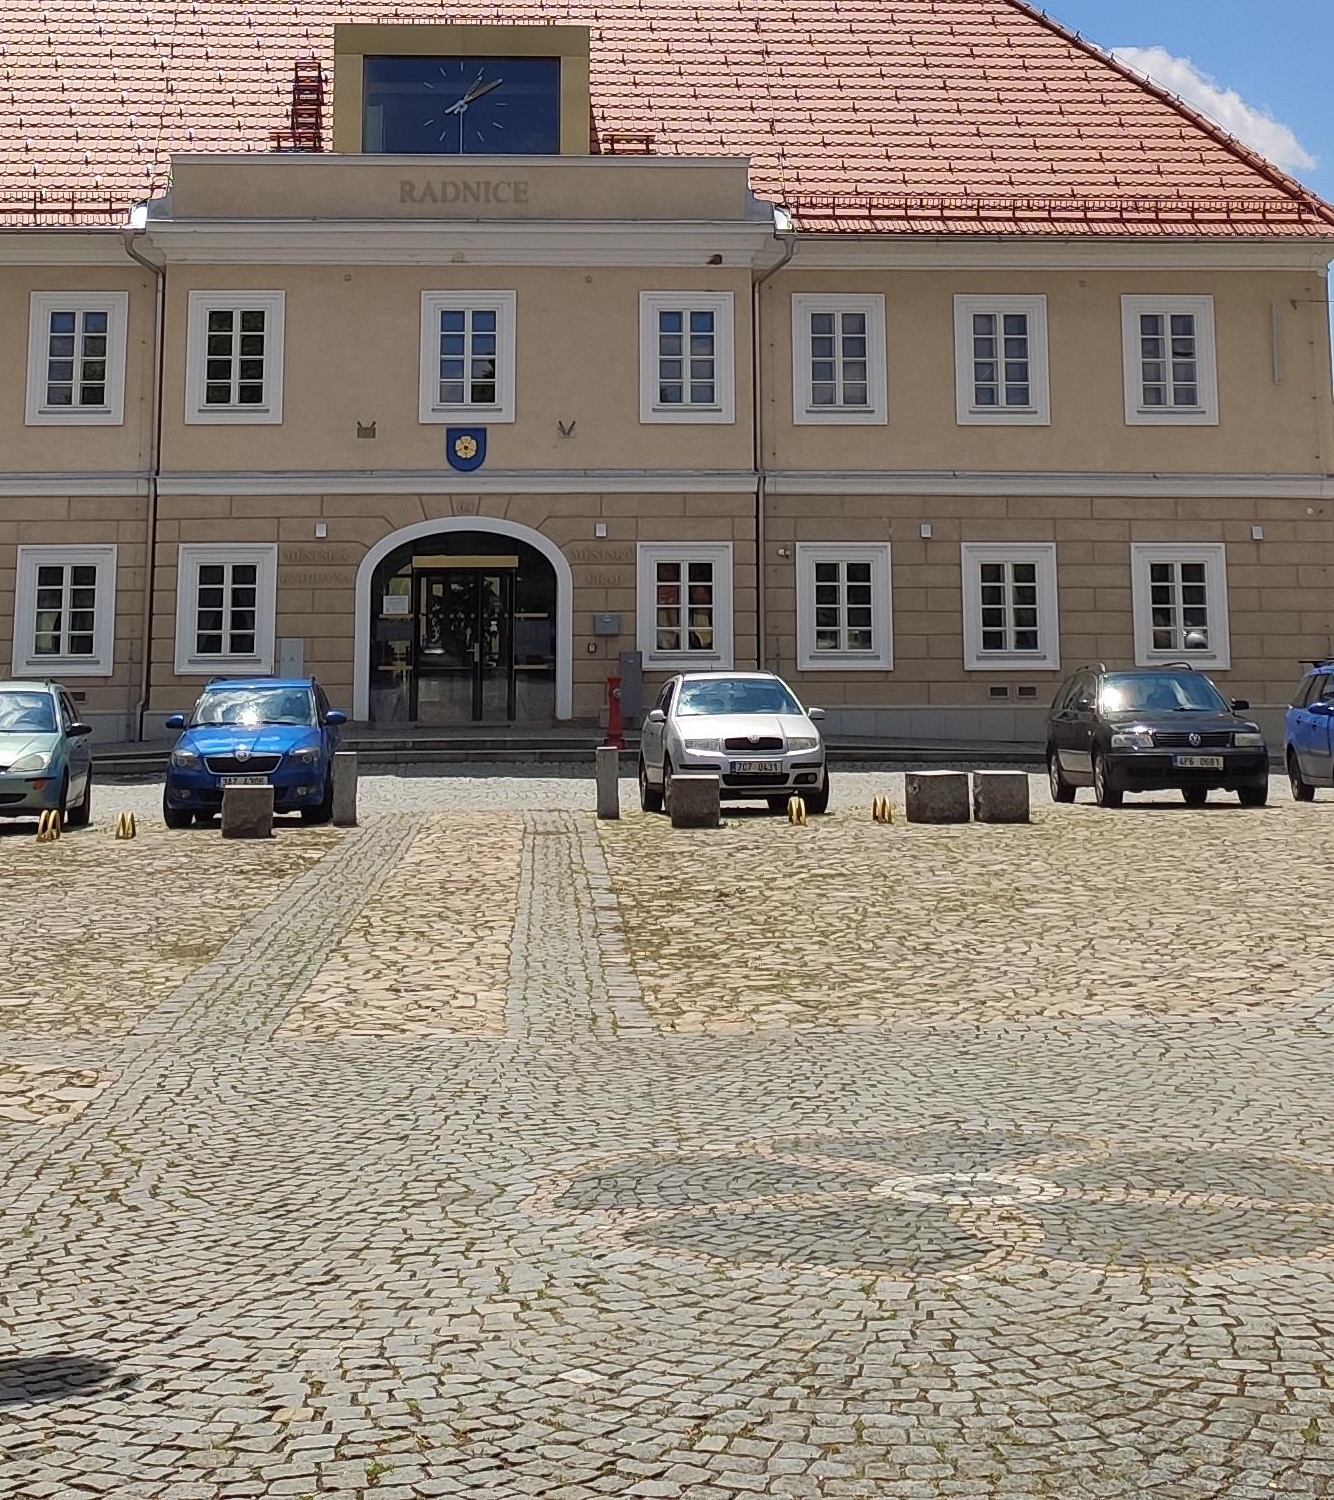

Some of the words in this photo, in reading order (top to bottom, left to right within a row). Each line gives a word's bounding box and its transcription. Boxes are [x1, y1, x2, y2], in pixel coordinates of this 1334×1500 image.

[399, 180, 530, 204] RADNICE
[737, 762, 752, 772] 7C7
[757, 762, 778, 772] 0431
